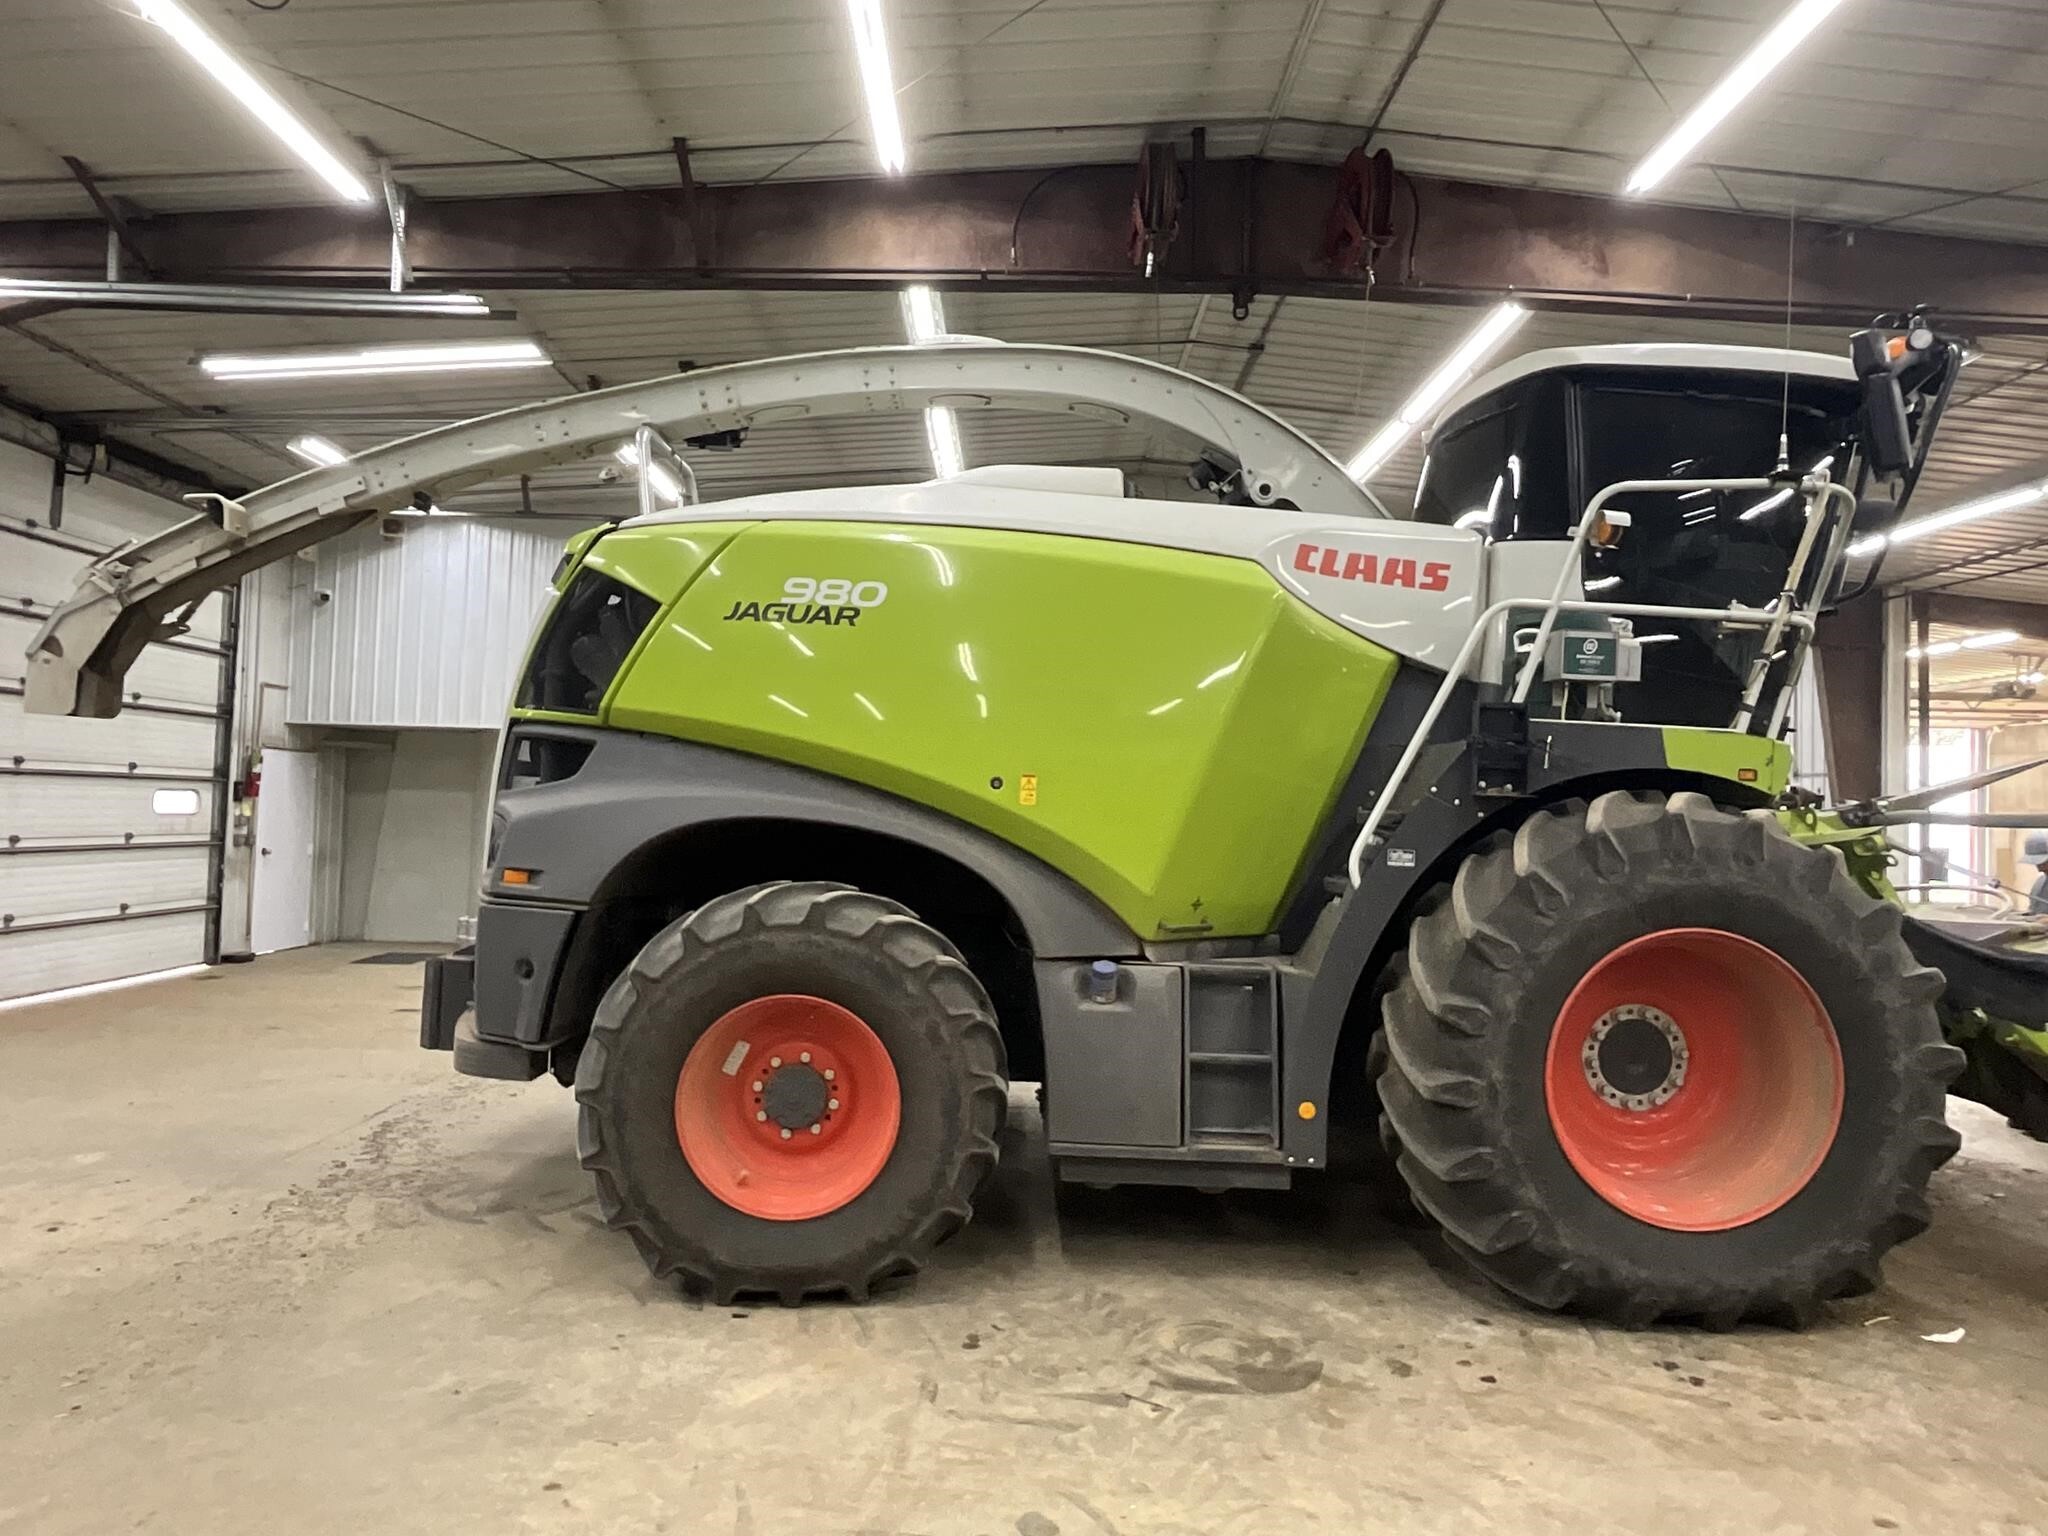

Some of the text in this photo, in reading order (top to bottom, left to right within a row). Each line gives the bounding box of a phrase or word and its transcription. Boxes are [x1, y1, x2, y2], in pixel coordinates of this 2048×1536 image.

[1294, 543, 1451, 592] CLAAS
[780, 576, 888, 608] 980
[723, 601, 861, 626] JAGUAR
